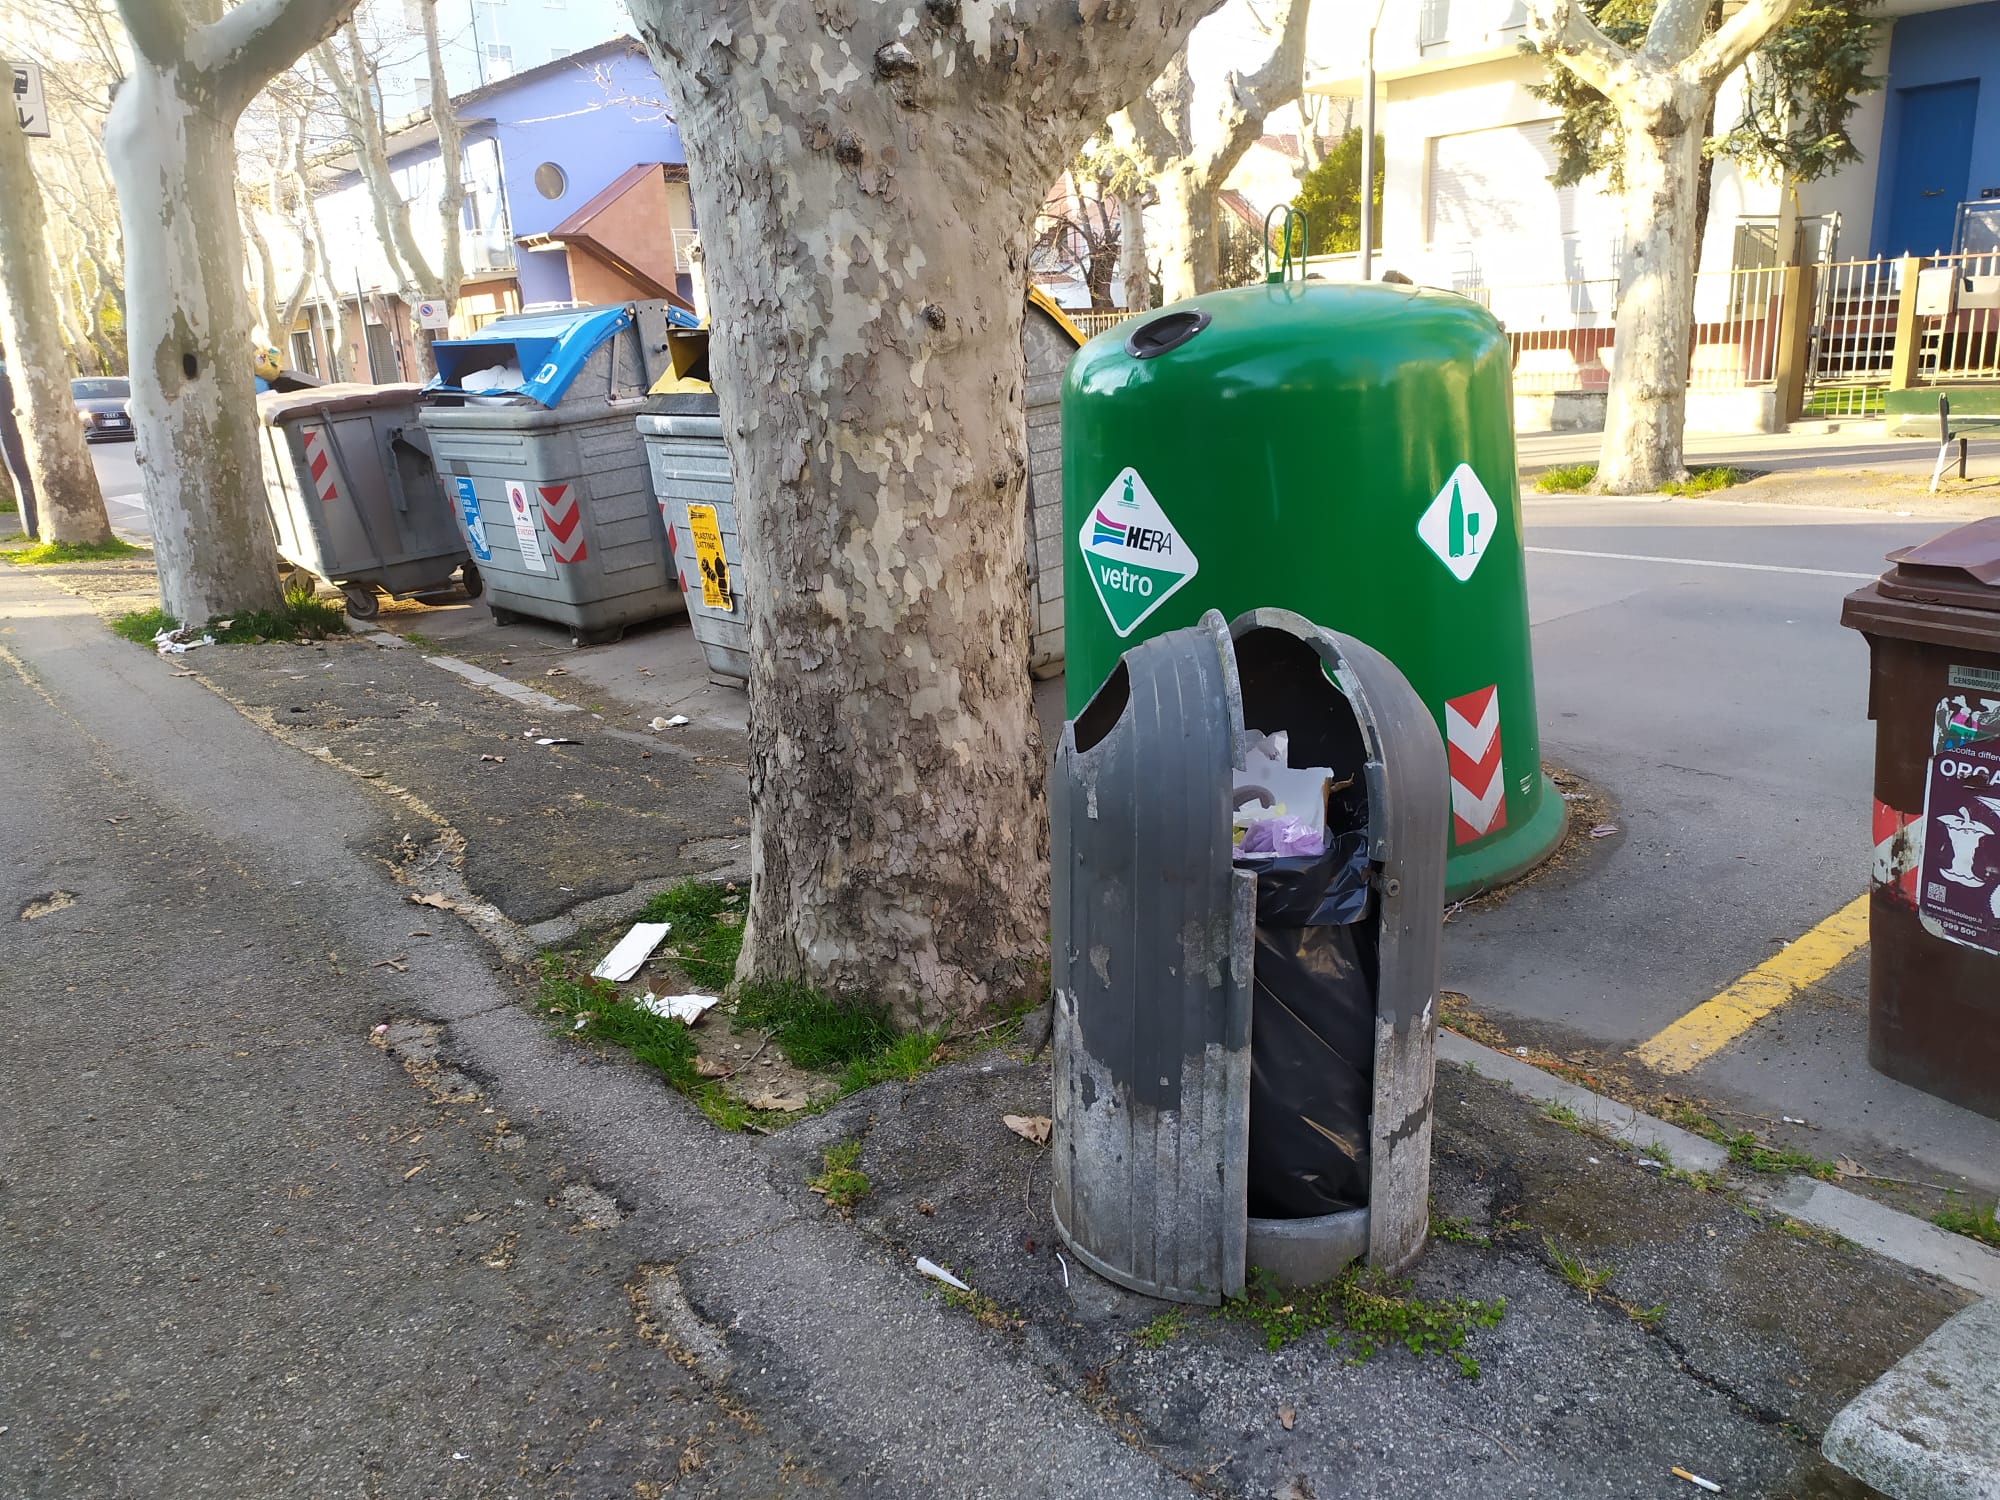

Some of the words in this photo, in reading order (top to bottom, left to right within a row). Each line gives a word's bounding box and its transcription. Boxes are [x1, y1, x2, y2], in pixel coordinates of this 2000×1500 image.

[1126, 525, 1173, 555] HERA
[1100, 564, 1153, 597] vetro
[1946, 746, 1976, 757] ccolta
[1943, 921, 1959, 932] 999
[1960, 926, 1977, 937] 500
